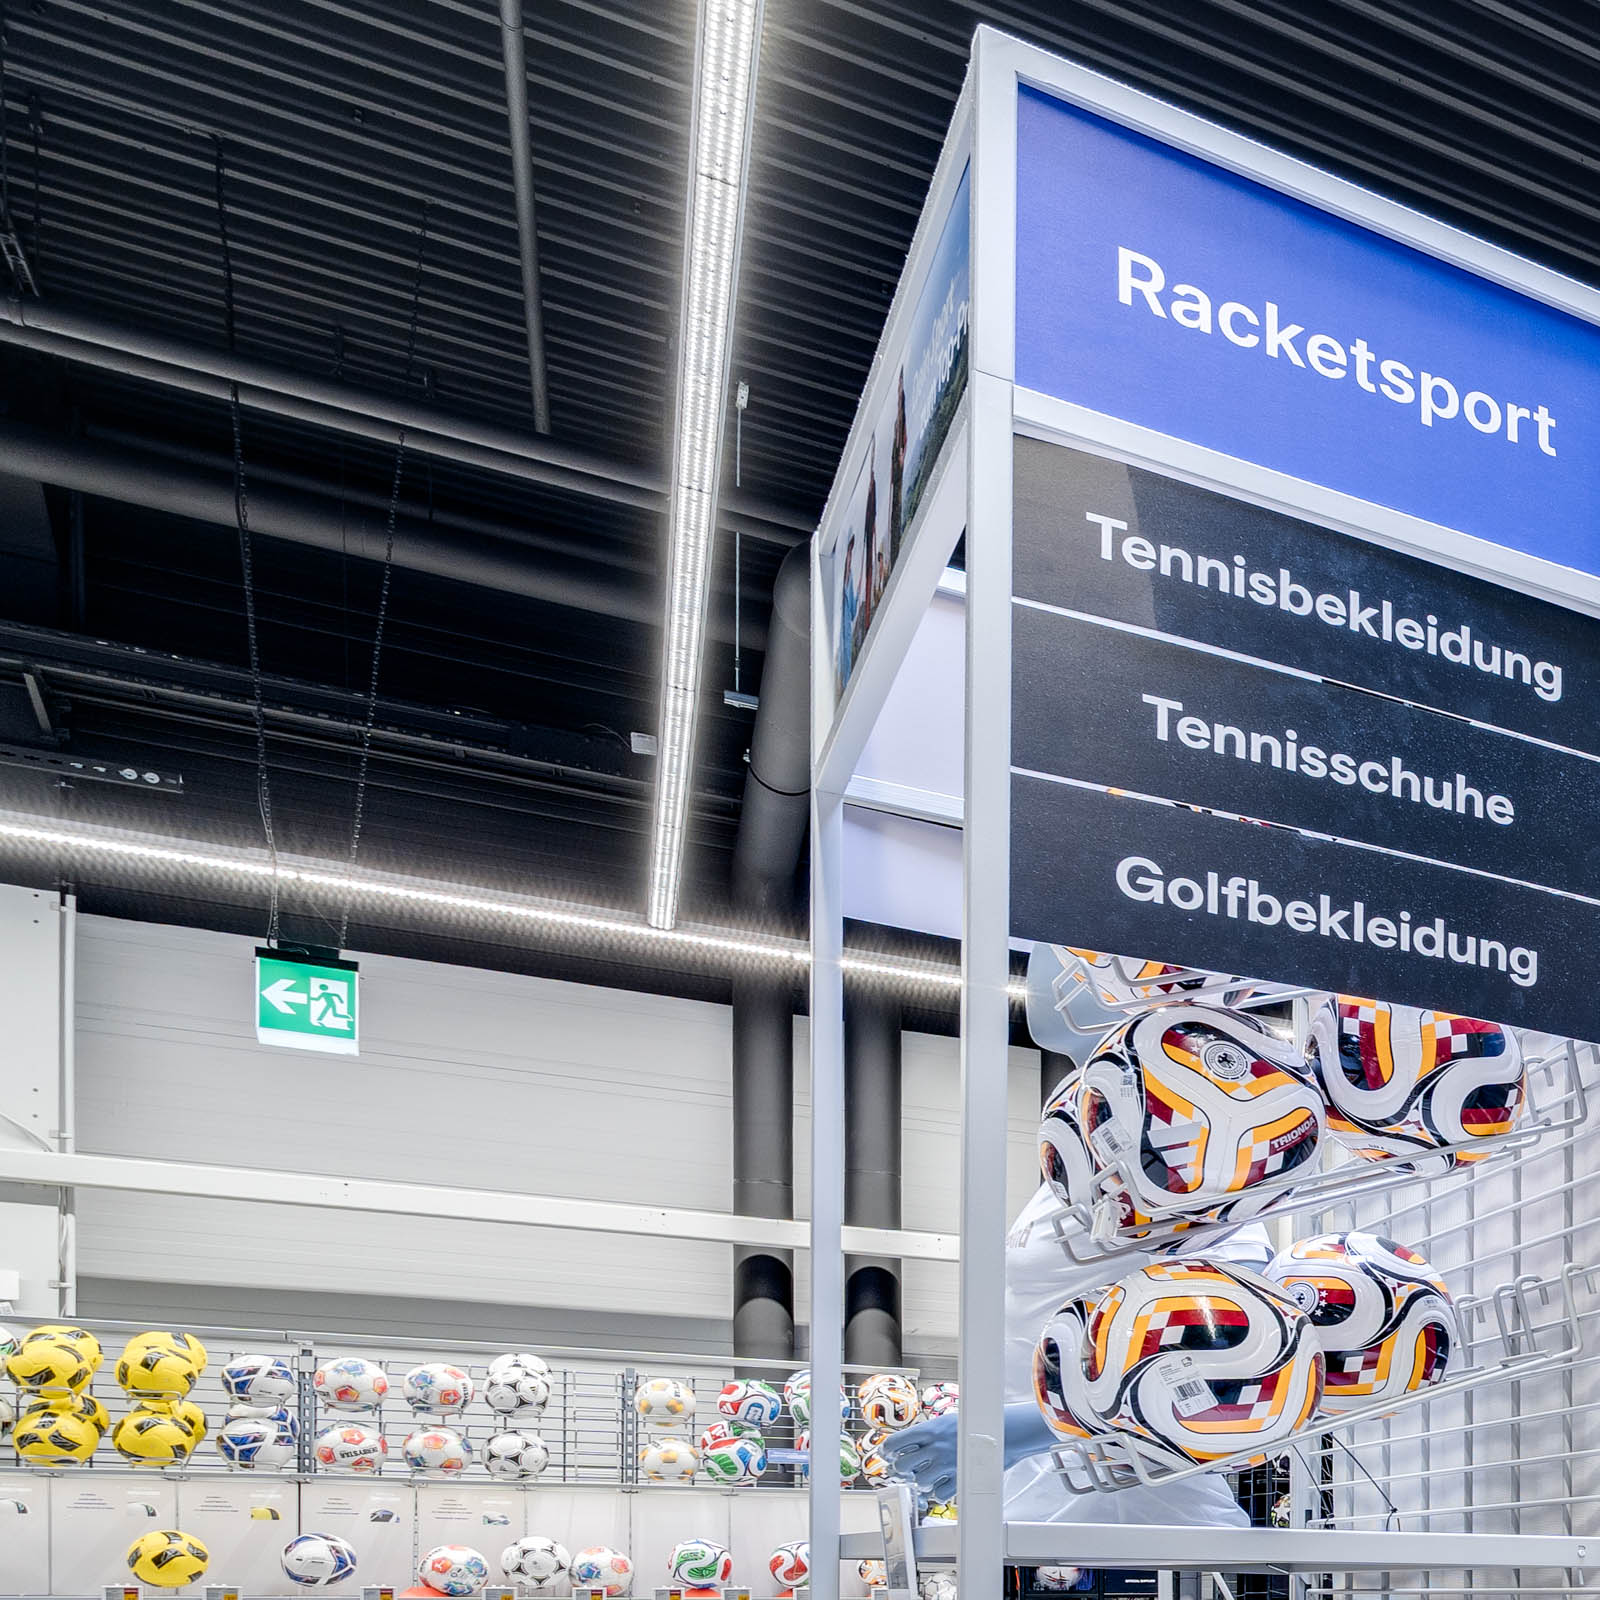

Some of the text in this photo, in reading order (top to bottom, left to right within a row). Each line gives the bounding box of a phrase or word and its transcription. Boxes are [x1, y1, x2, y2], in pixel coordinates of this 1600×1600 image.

[1117, 245, 1558, 458] Racketsport
[1084, 511, 1564, 703] Tennisbekleidung
[1142, 693, 1517, 826] Tennisschuhe
[1114, 855, 1539, 987] Golfbekleidung
[1270, 1116, 1317, 1148] TRIONDA
